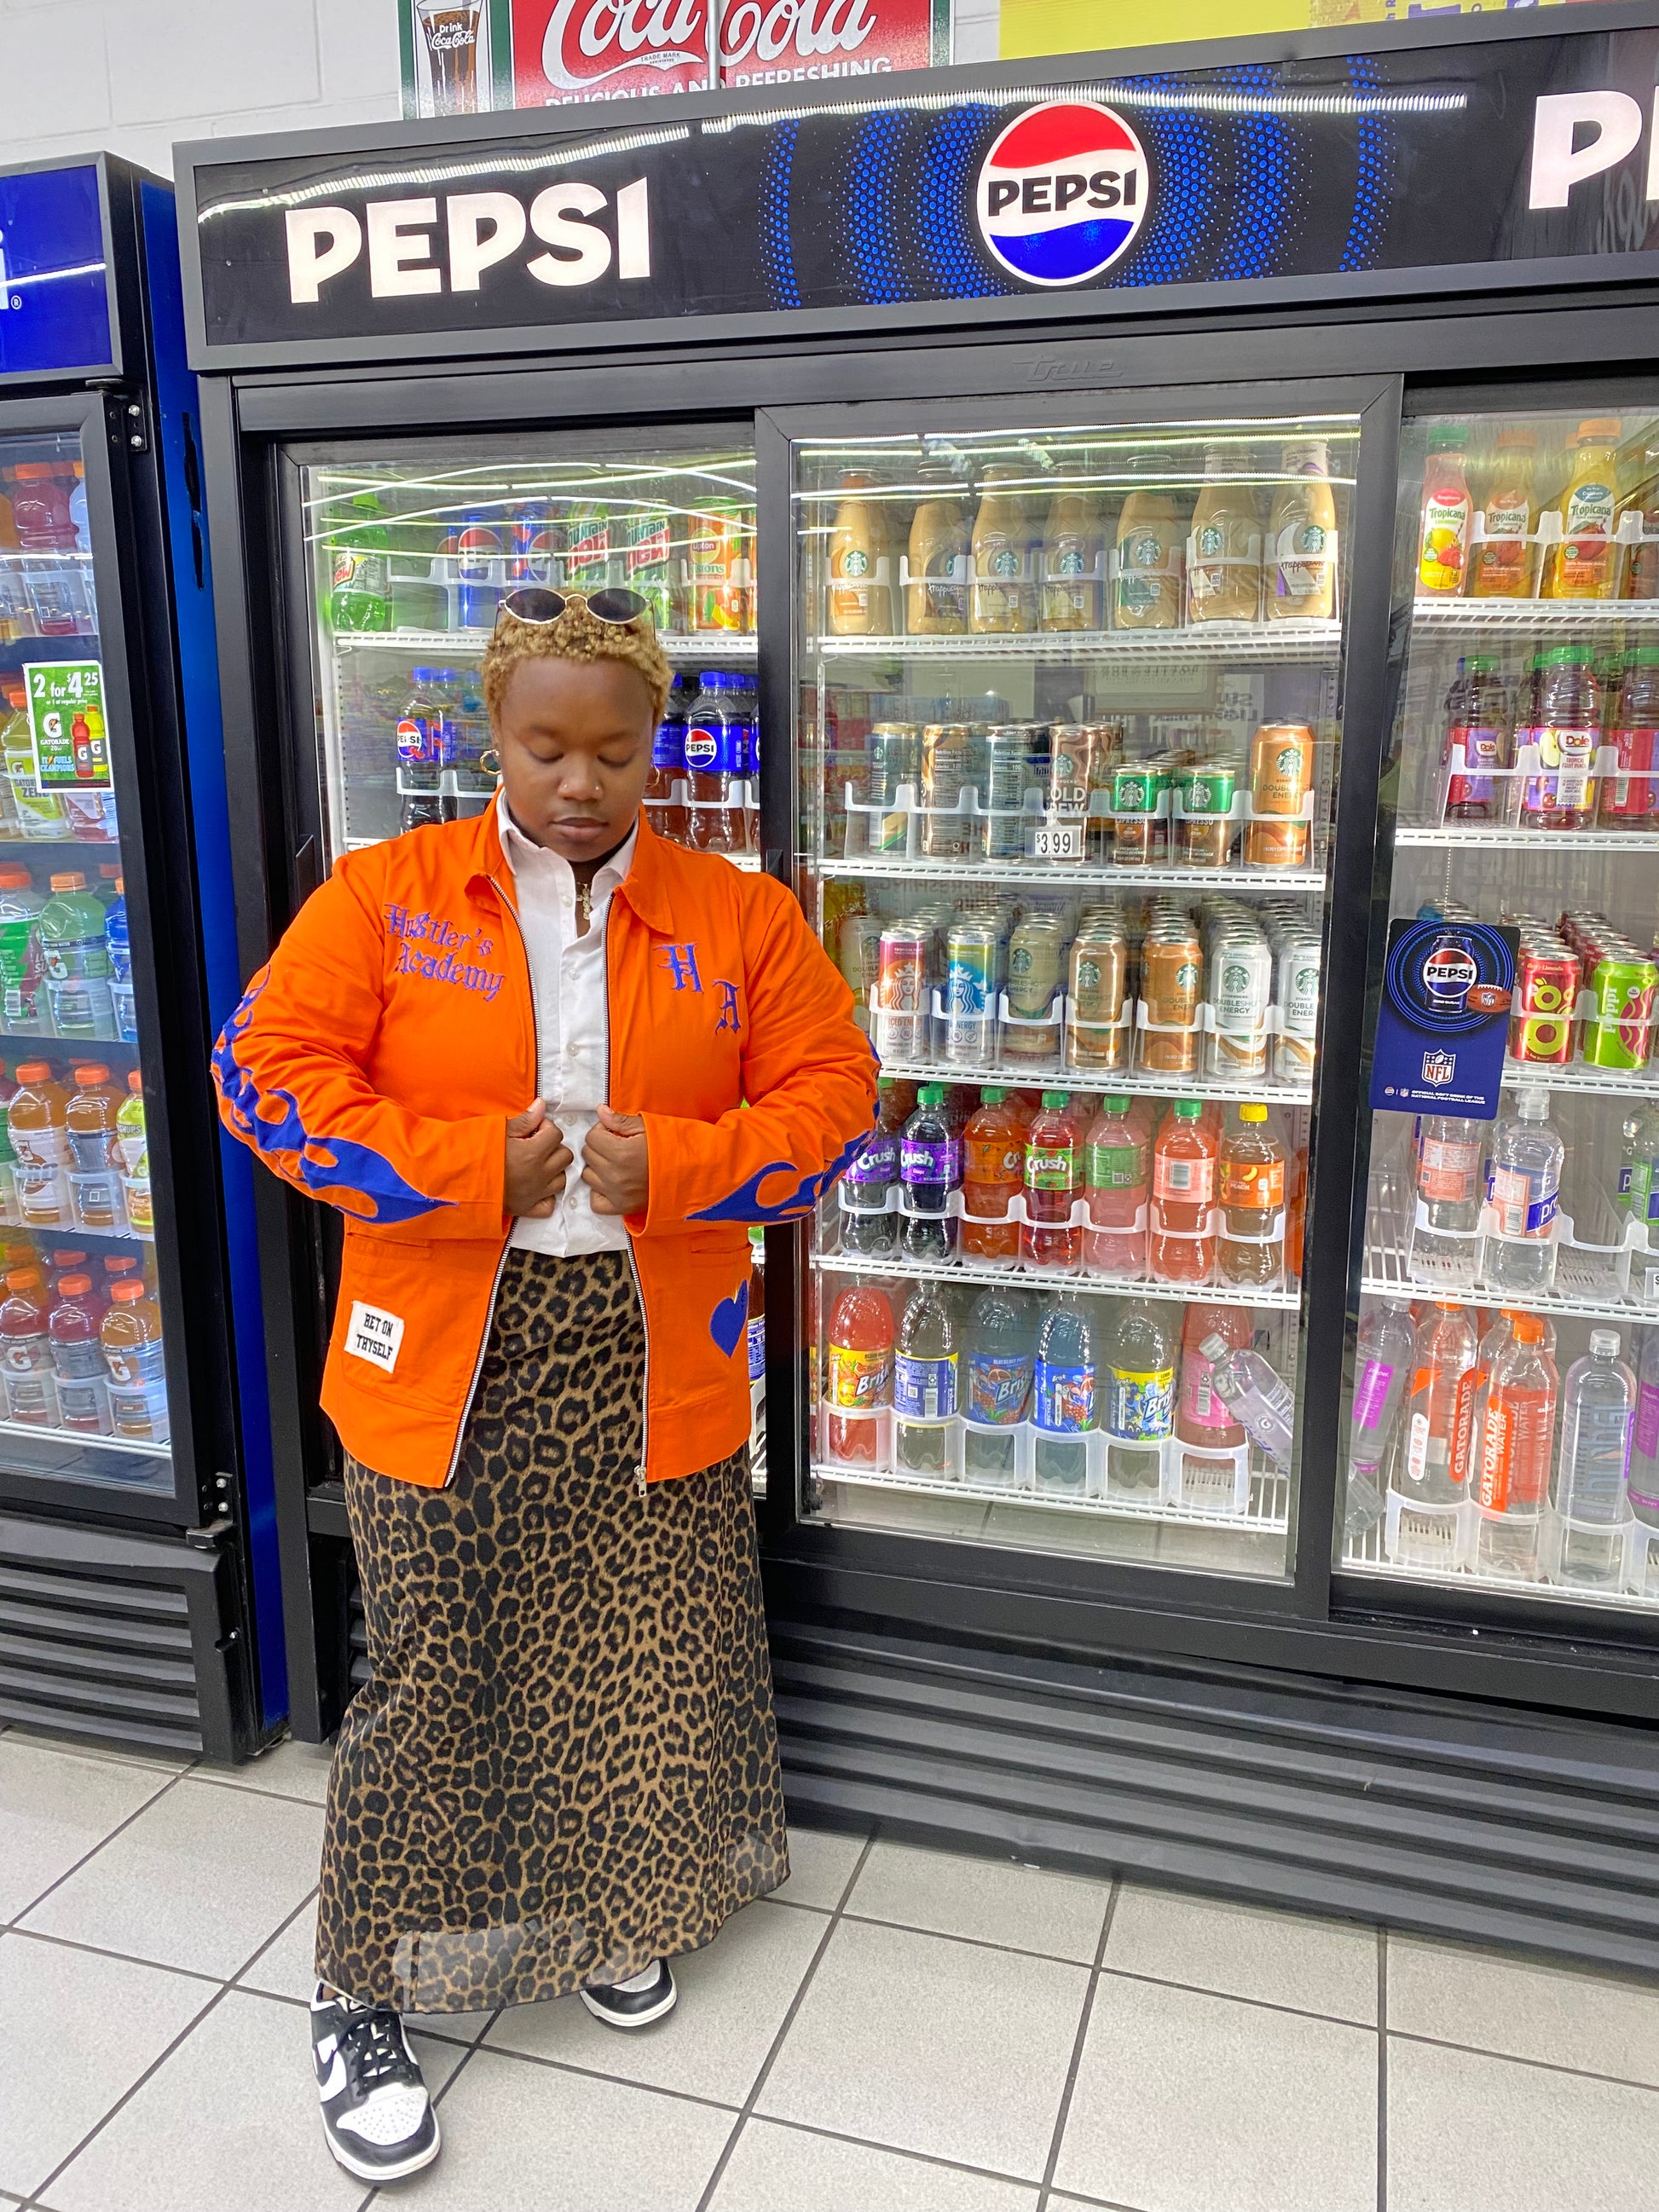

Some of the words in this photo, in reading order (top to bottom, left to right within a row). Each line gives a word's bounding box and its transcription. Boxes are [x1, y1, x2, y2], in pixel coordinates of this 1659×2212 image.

[439, 23, 463, 34] Drink
[1529, 90, 1659, 210] P
[988, 169, 1137, 217] PEPSI
[285, 176, 650, 303] PEPSI
[1429, 507, 1465, 520] Tropicana
[1488, 511, 1526, 523] Tropicana
[1570, 503, 1611, 517] Tropicana
[693, 541, 715, 551] Lipton
[33, 673, 46, 697] 2
[50, 682, 66, 697] for
[43, 712, 63, 738] G
[686, 743, 714, 753] PEPSI
[1565, 736, 1589, 744] Dole
[54, 756, 72, 765] FUELS
[1049, 786, 1086, 802] OLD
[1037, 831, 1072, 855] $3.99
[43, 950, 68, 979] G
[393, 941, 506, 1002] Academy
[652, 942, 705, 994] H
[1426, 965, 1473, 980] PEPSI
[711, 979, 743, 1036] A
[1603, 988, 1620, 1034] poppi
[888, 1016, 902, 1026] ICED
[1425, 1065, 1449, 1081] NFL
[858, 1146, 895, 1170] Crush
[1026, 1155, 1067, 1173] Crush
[363, 1313, 382, 1332] BET
[381, 1320, 394, 1337] ON
[7, 1346, 32, 1370] G
[356, 1333, 394, 1360] THYSELF
[107, 1355, 131, 1381] G
[1454, 1381, 1471, 1474] GATORADE
[1497, 1413, 1507, 1455] WATER
[1482, 1407, 1499, 1507] GATORADE
